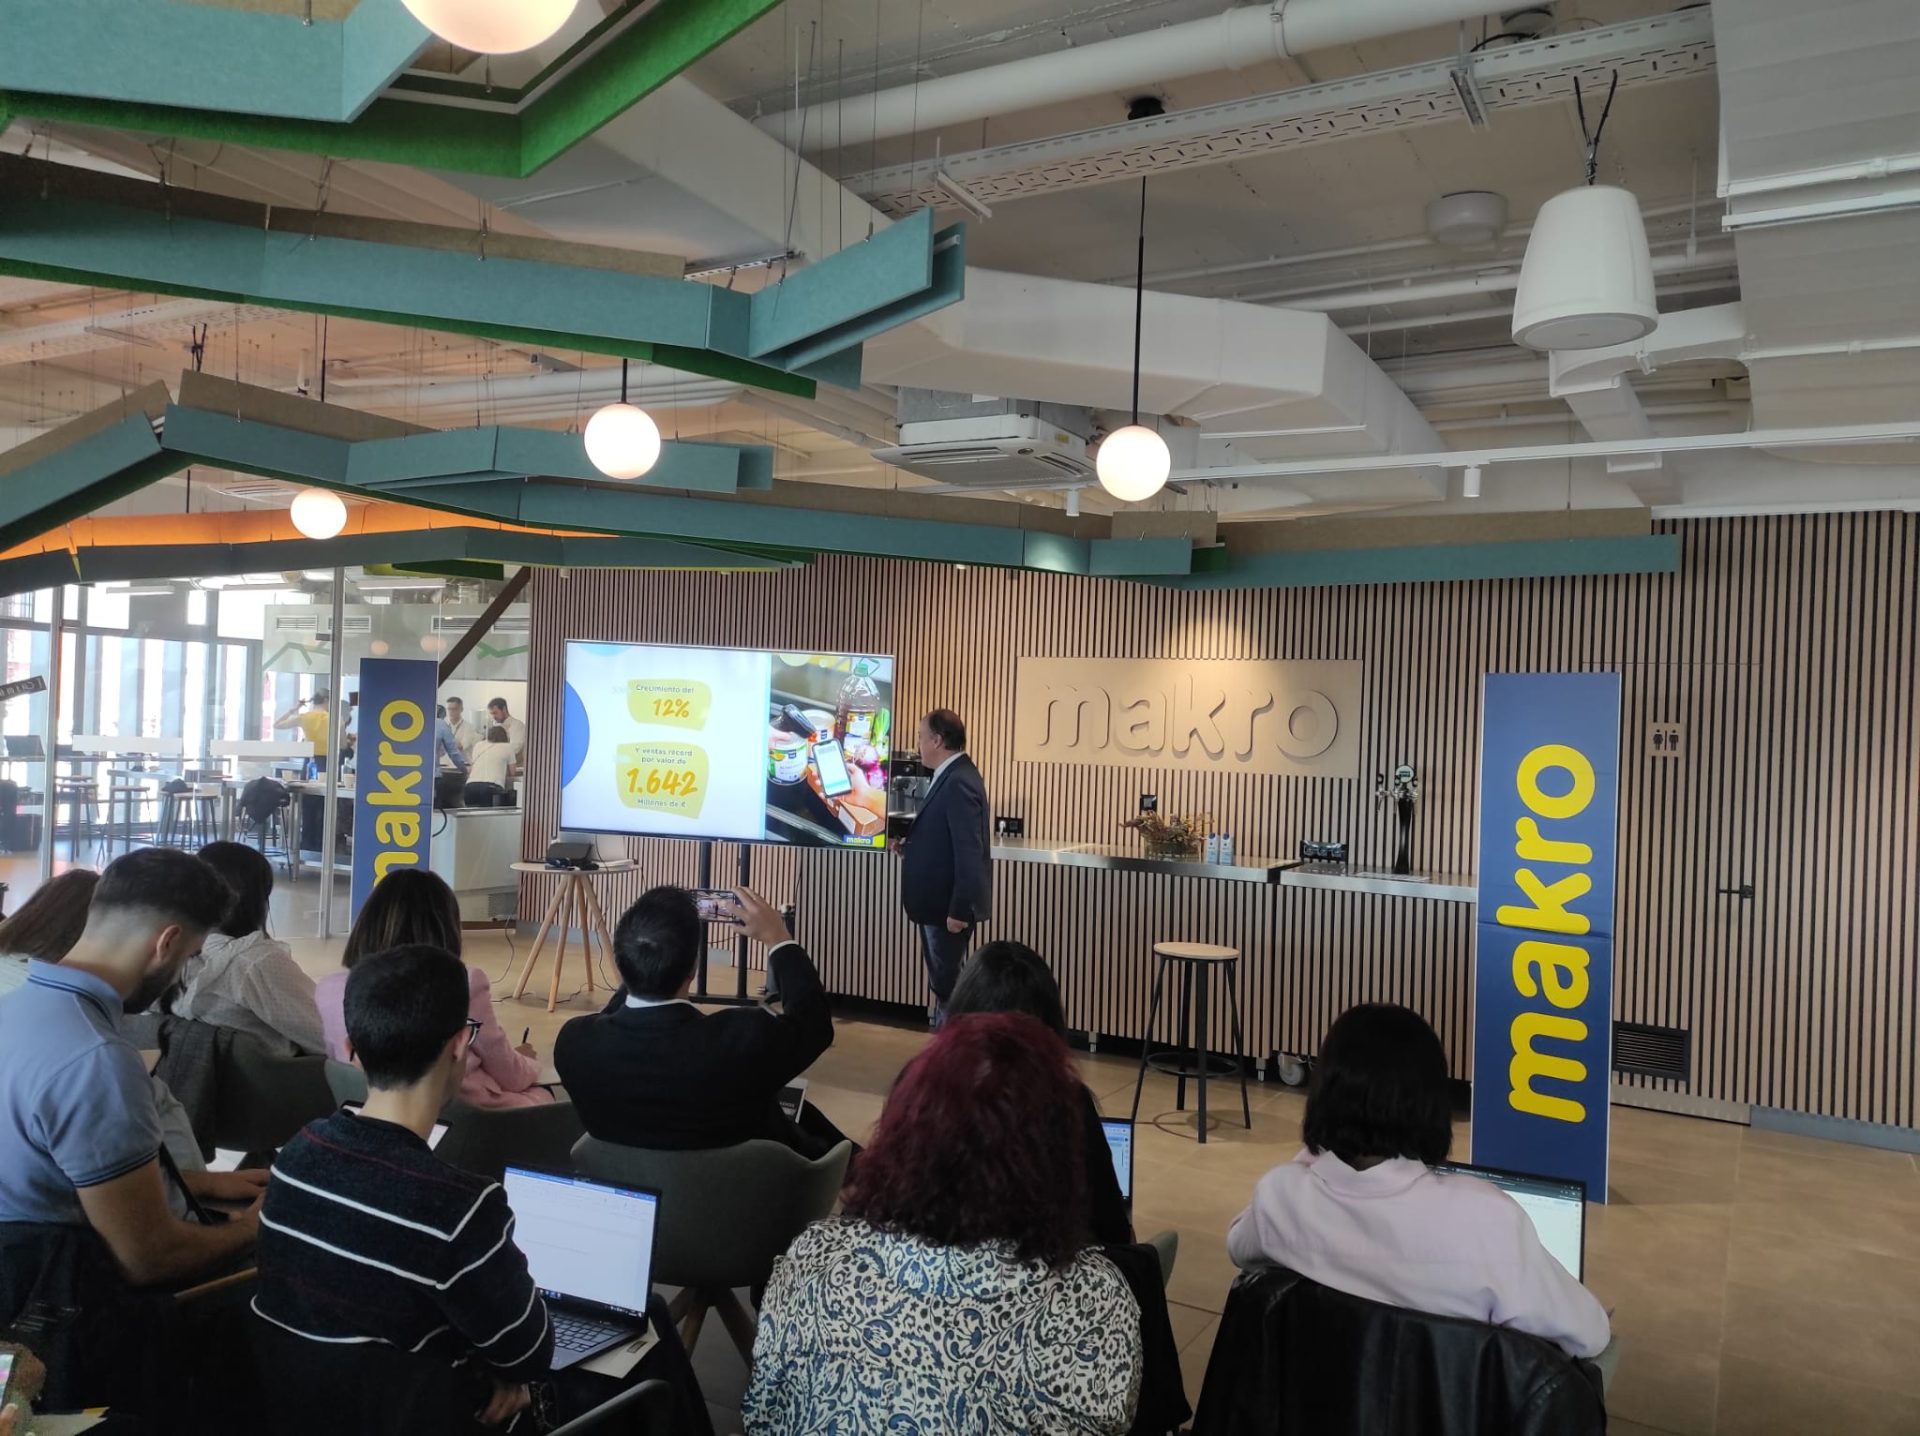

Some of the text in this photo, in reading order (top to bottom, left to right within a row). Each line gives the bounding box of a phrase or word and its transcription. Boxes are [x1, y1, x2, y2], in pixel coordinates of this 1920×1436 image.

[653, 698, 690, 718] 12%
[1037, 672, 1339, 760] makro
[626, 767, 699, 797] 1.642
[1496, 744, 1596, 1123] makro
